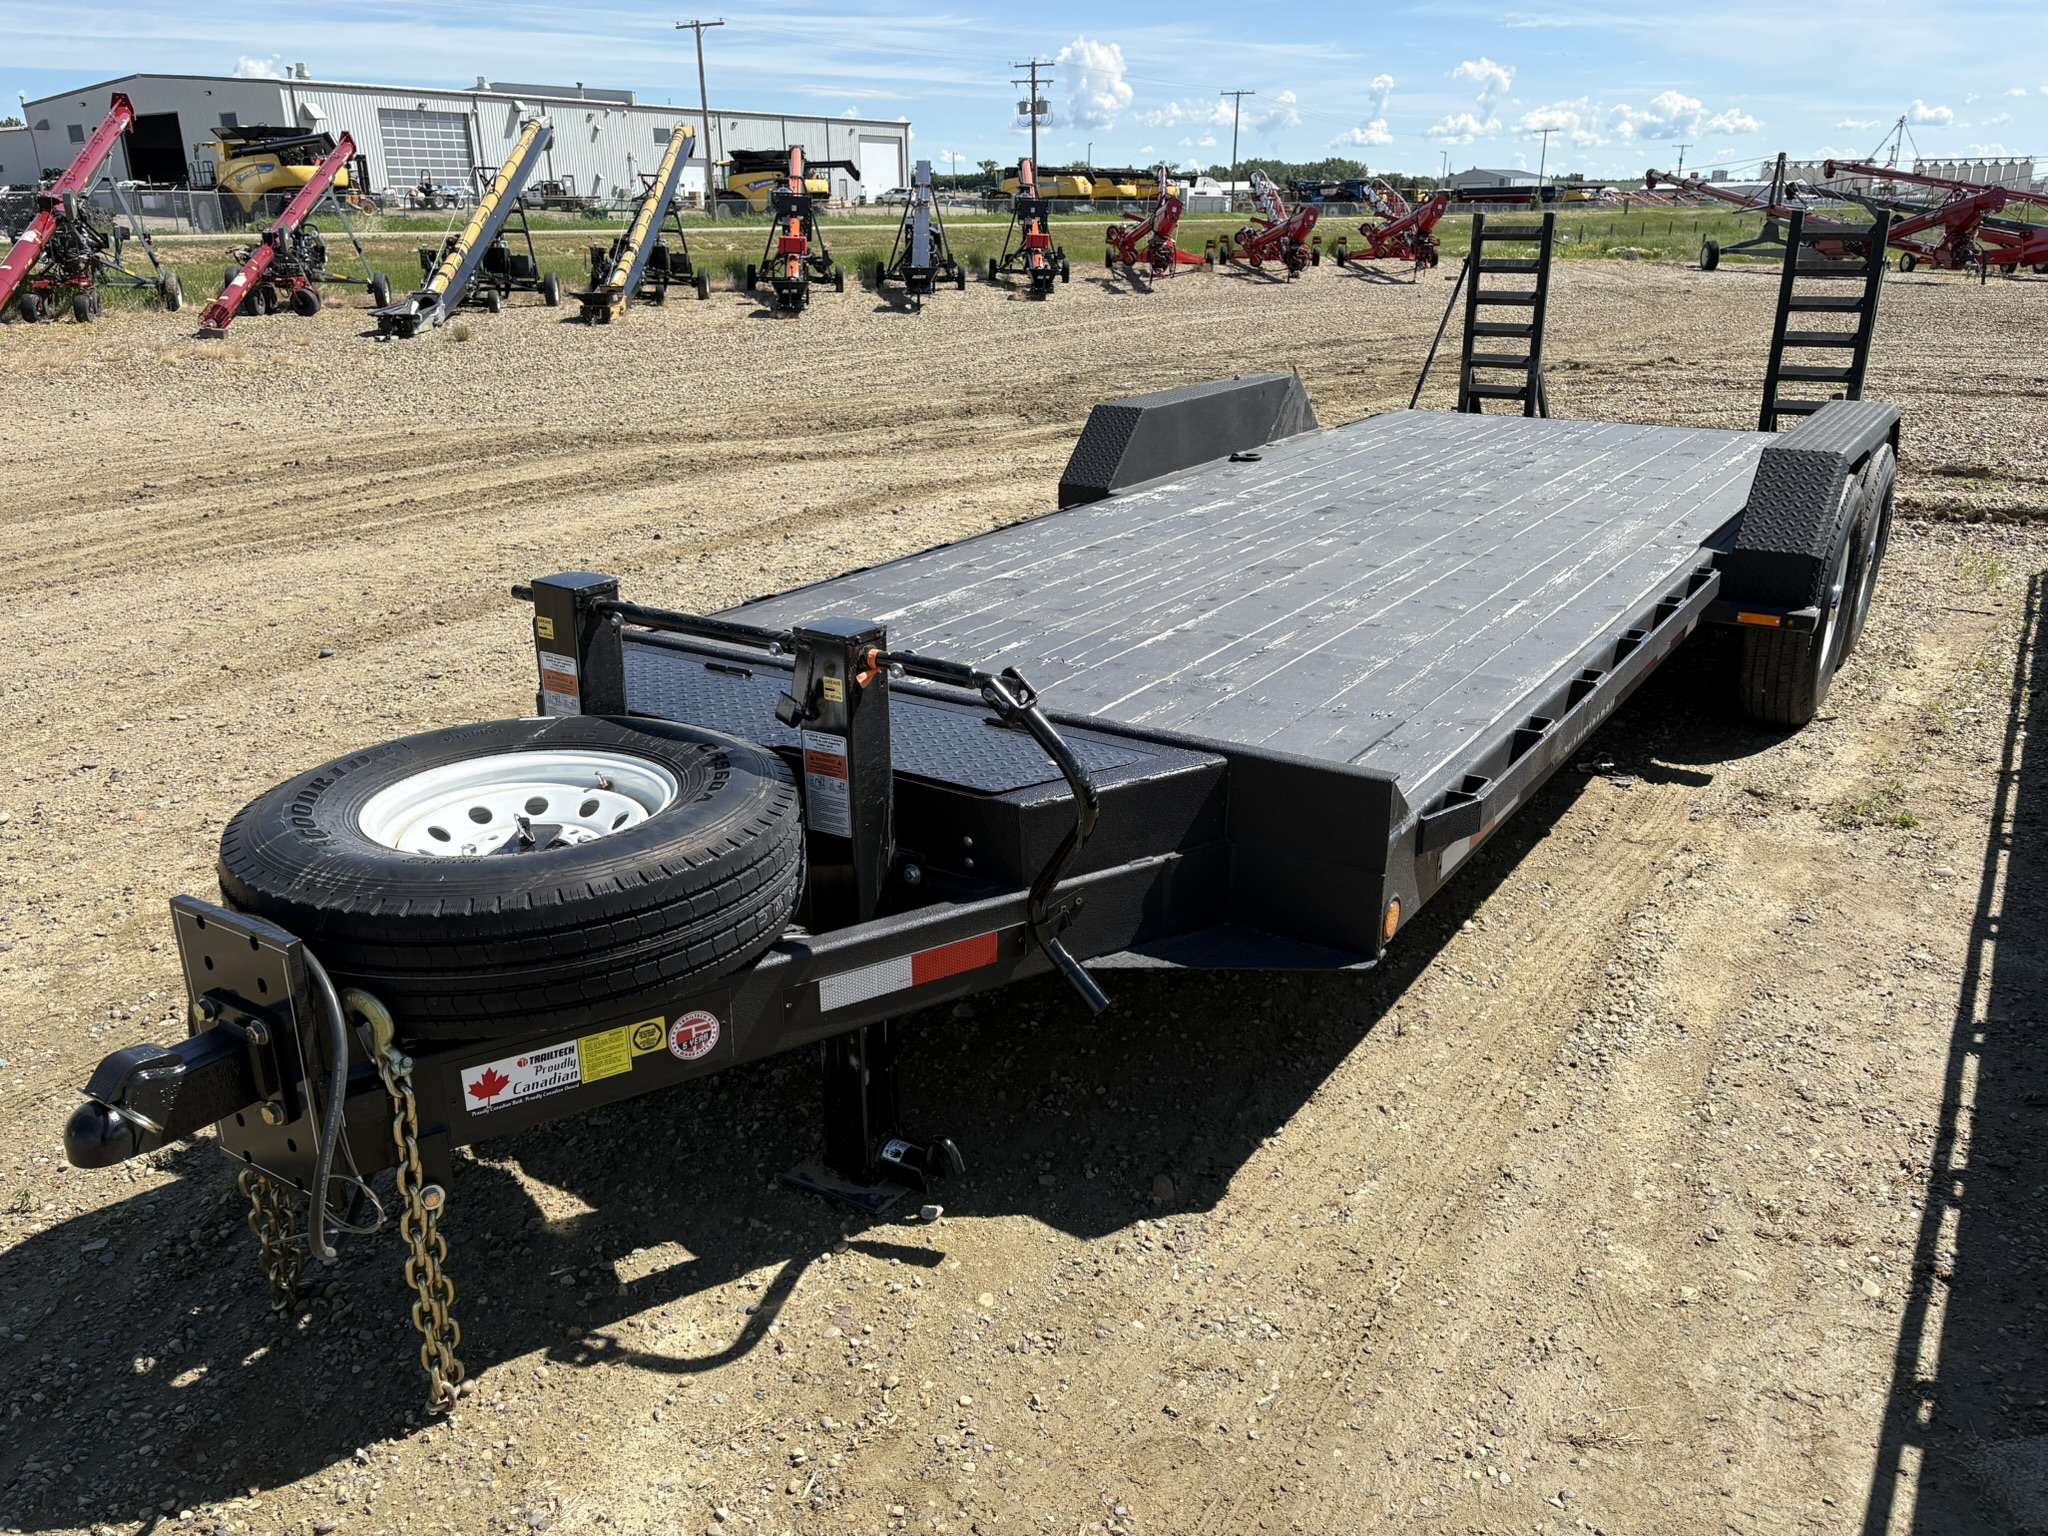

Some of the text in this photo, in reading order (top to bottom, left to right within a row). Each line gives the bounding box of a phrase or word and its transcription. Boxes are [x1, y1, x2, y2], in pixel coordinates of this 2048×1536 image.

[529, 1044, 576, 1066] TRAILTECH
[534, 1057, 577, 1076] Proudly
[513, 1070, 578, 1095] Canadian
